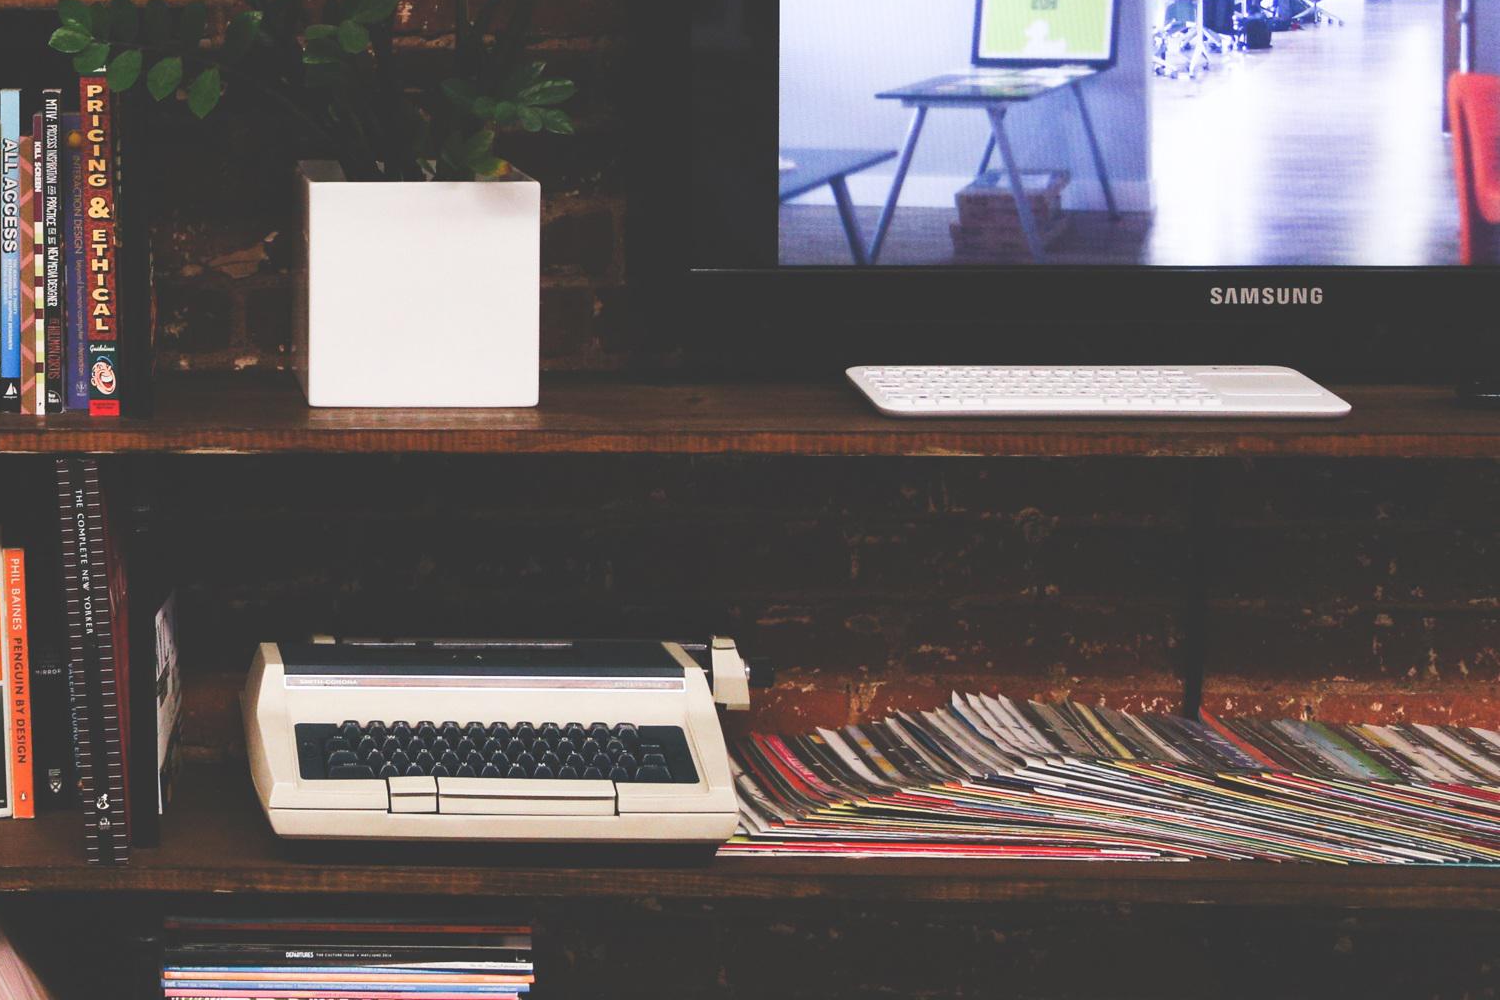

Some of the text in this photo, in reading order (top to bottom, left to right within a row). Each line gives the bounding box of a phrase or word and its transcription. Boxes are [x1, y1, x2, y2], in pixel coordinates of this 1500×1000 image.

[3, 139, 18, 174] ALL
[3, 177, 18, 254] ACCESS
[87, 85, 110, 331] PRICING & ETHICAL
[1210, 287, 1323, 304] SAMSUNG
[75, 490, 93, 634] THE COMPLETE NEW YORKER
[11, 558, 26, 764] PHIL BAINES PENGUIN BY DESIGN
[285, 951, 314, 959] DEPARTURES
